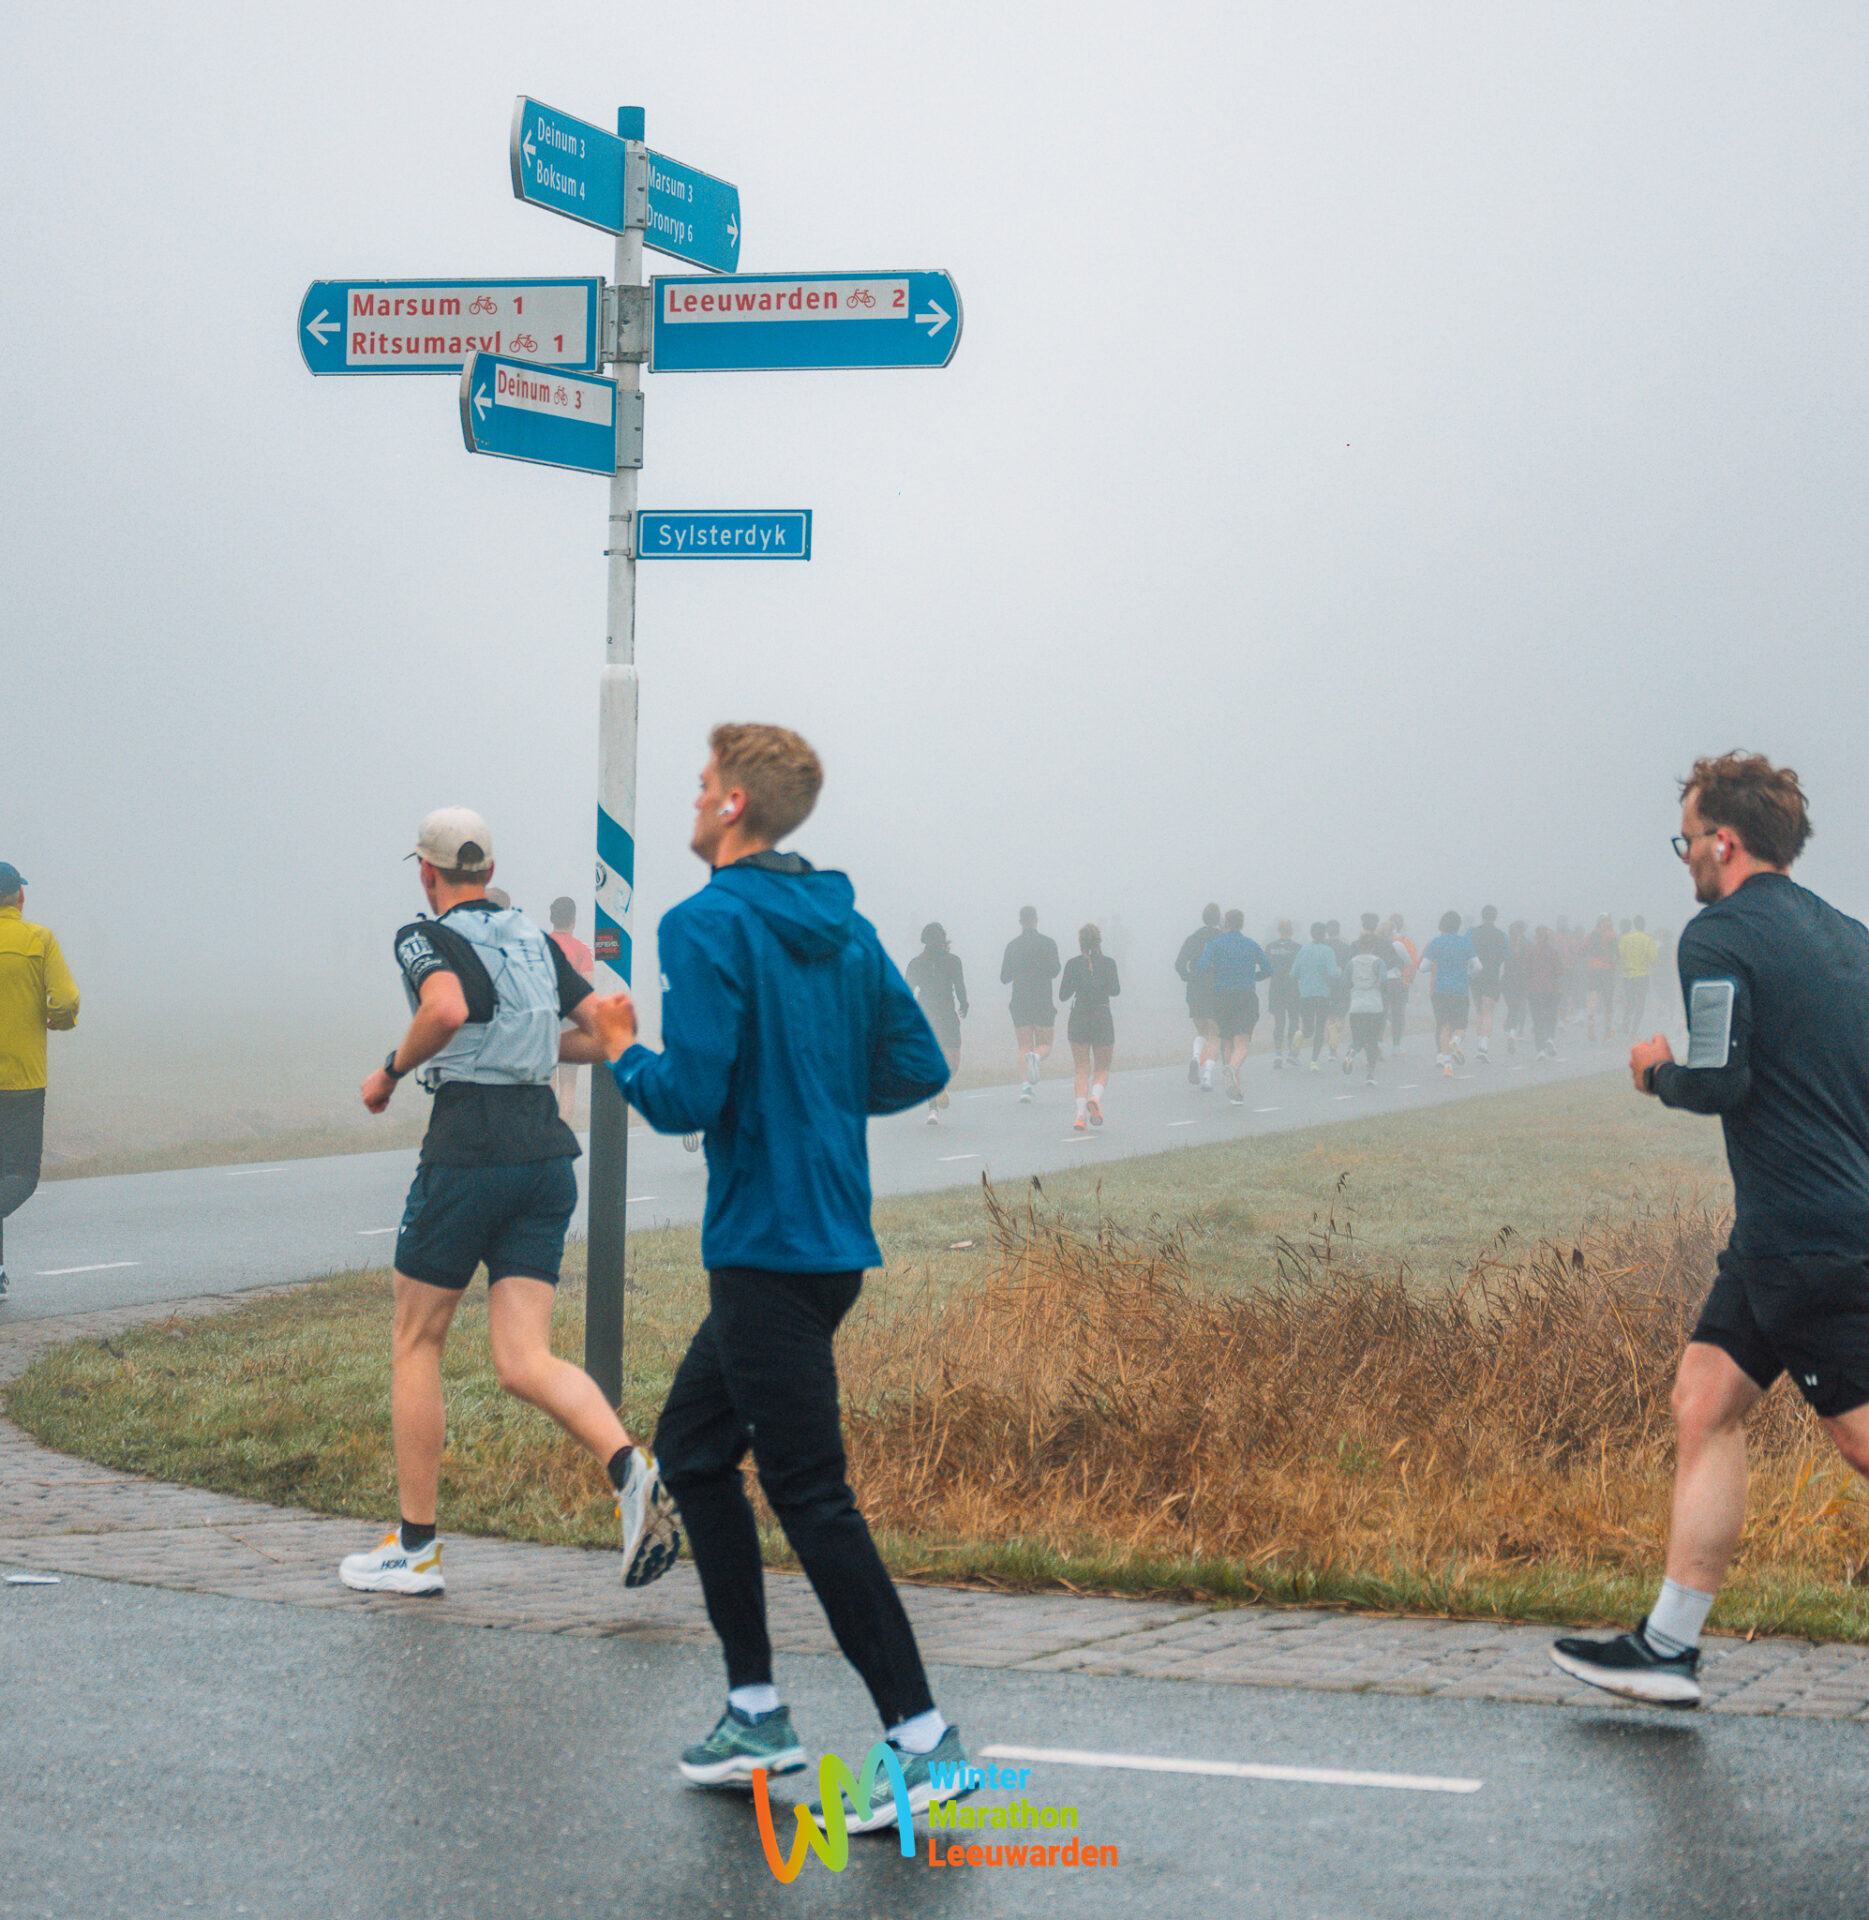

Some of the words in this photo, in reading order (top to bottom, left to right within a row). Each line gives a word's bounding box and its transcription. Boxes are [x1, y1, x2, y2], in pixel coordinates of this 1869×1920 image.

[538, 117, 577, 155] Deinum
[580, 139, 585, 159] 3
[537, 159, 577, 198] Boksum
[579, 182, 585, 201] 4
[648, 163, 685, 201] Marsum
[688, 184, 693, 203] 3
[647, 203, 685, 245] Dronryp
[688, 224, 693, 243] 6
[352, 294, 461, 316] Marsum
[513, 296, 523, 314] 1
[669, 287, 838, 313] Leeuwarden
[892, 289, 905, 308] 2
[553, 334, 563, 352] 1
[498, 370, 550, 403] Deinum
[575, 390, 582, 409] 3
[659, 524, 786, 550] Sylsterdyk
[380, 1559, 408, 1570] HOKA
